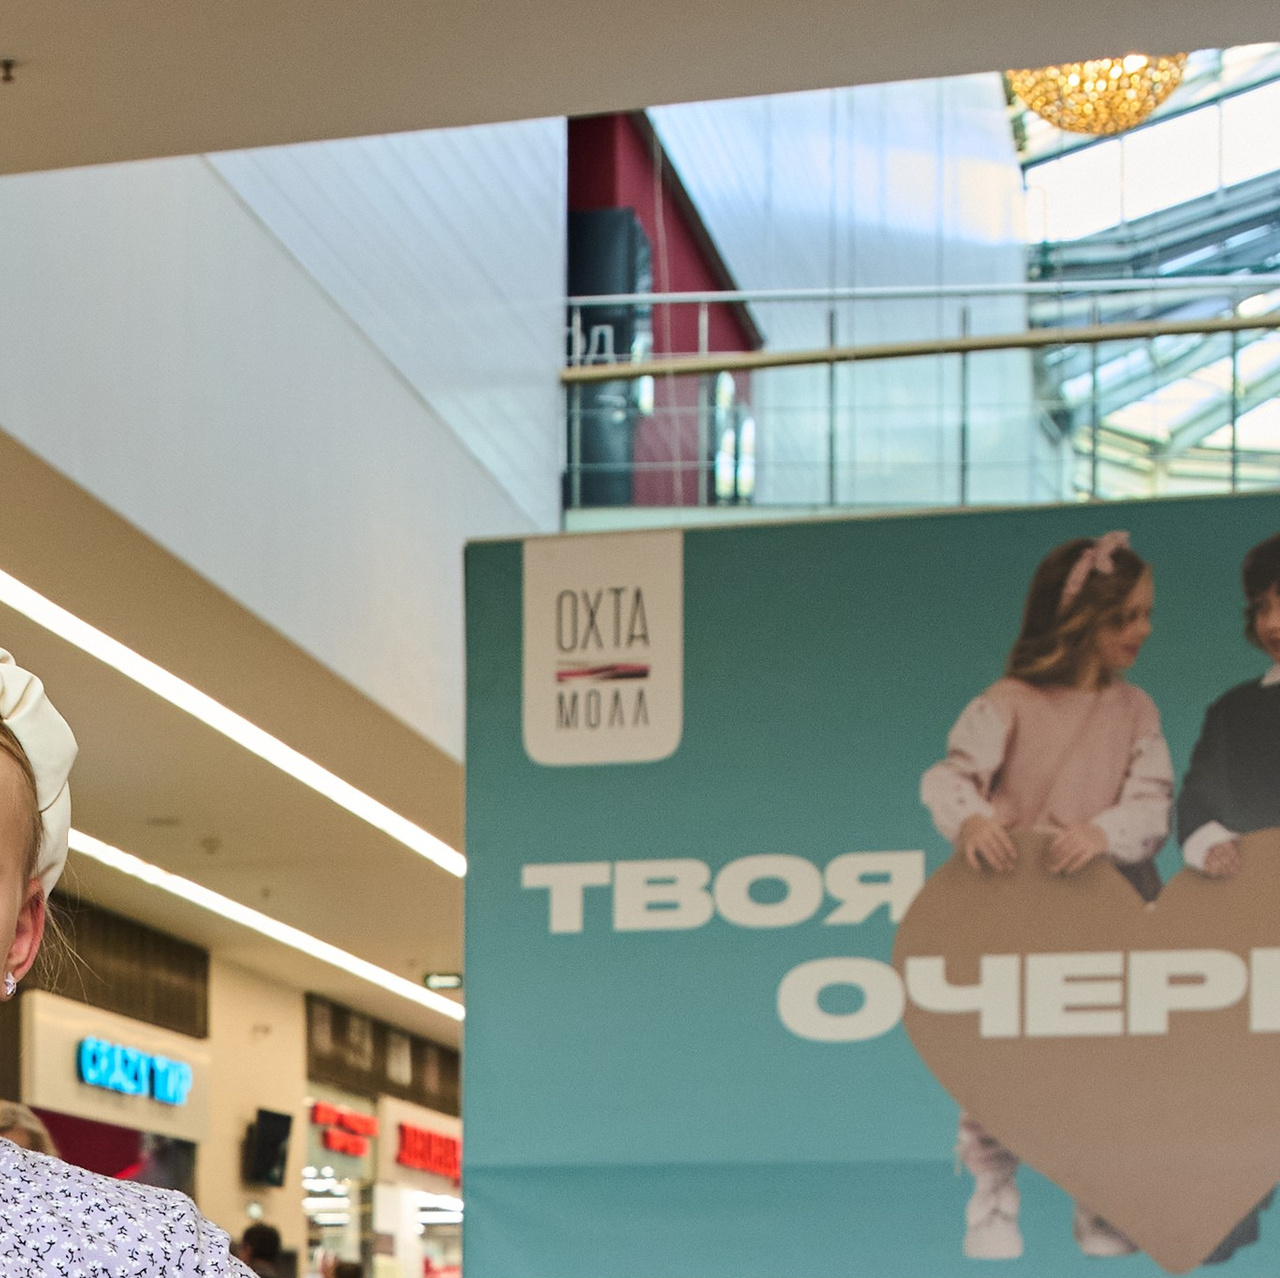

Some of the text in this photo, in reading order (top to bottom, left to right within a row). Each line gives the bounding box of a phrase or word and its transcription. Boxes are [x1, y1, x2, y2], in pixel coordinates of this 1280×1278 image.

[555, 586, 651, 653] ОХТА
[556, 687, 650, 729] МОЛЛ
[521, 850, 925, 934] ТВОЯ
